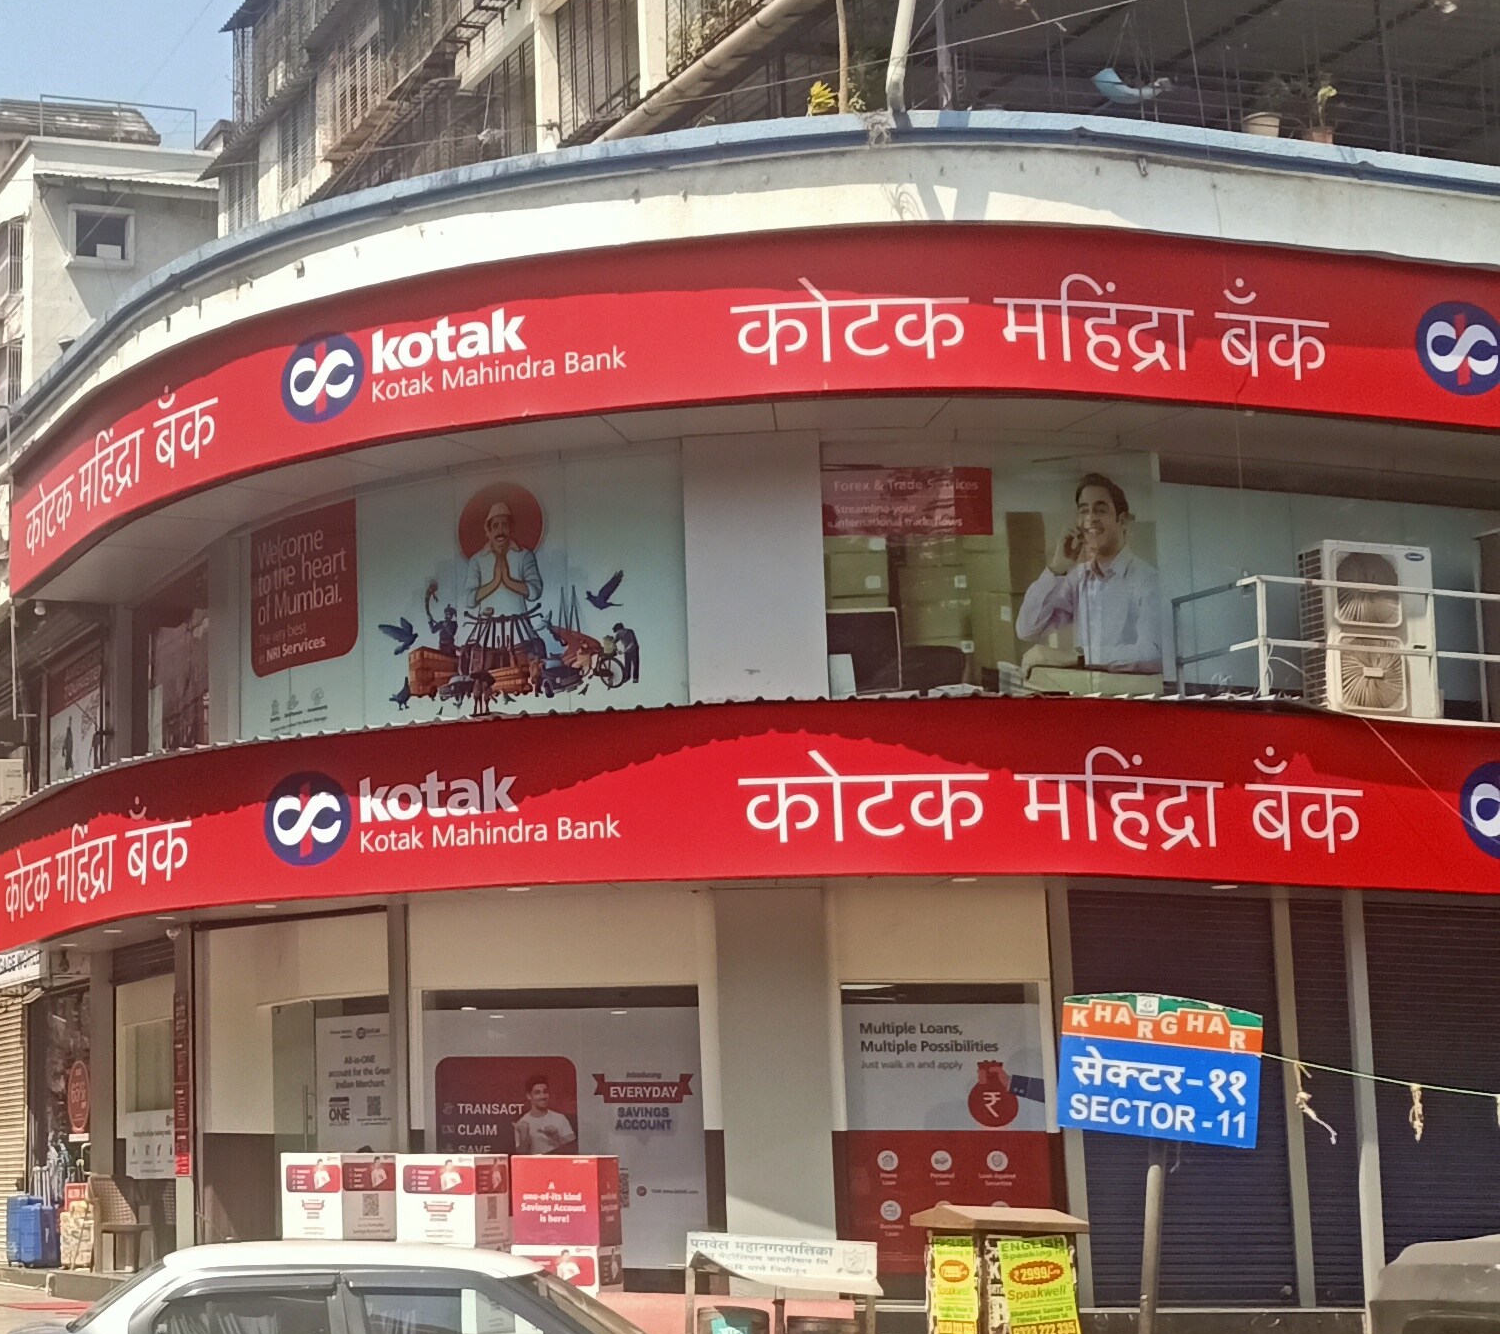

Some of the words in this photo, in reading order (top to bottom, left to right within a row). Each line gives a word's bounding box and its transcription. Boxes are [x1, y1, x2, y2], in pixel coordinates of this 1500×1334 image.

[729, 277, 969, 366] कोटक
[993, 273, 1195, 373] महिंद्रा
[1214, 277, 1330, 381] बँक
[371, 308, 526, 370] kotak
[371, 371, 434, 403] Kotak
[441, 354, 556, 393] Mahindra
[564, 345, 627, 375] Bank
[25, 474, 75, 556] कोटक
[78, 427, 145, 512] महिंद्रा
[152, 385, 219, 469] बँक
[834, 481, 870, 492] Forex
[873, 480, 884, 491] &
[887, 479, 923, 491] Trade
[257, 529, 324, 567] Welcome
[258, 574, 271, 597] to
[273, 565, 296, 589] the
[301, 547, 347, 582] heart
[258, 595, 270, 626] of
[274, 575, 343, 619] Mumbai.
[266, 646, 281, 662] NRI
[282, 636, 326, 657] Services
[359, 766, 520, 824] kotak
[737, 749, 990, 844] कोटक
[1013, 746, 1224, 851] महिंद्रा
[1244, 746, 1364, 854] बँक
[360, 825, 424, 854] Kotak
[431, 815, 548, 848] Mahindra
[557, 813, 621, 841] Bank
[3, 849, 52, 922] कोटक
[55, 823, 117, 904] महिंद्रा
[124, 796, 193, 886] बँक
[859, 1022, 917, 1037] Multiple
[919, 1023, 963, 1036] Loans,
[1070, 1004, 1248, 1050] KHARGHAR
[860, 1040, 917, 1055] Multiple
[921, 1040, 999, 1053] Possibilities
[881, 1060, 904, 1069] walk
[918, 1060, 936, 1069] and
[938, 1061, 963, 1071] apply
[609, 1085, 678, 1098] EVERYDAY
[329, 1108, 350, 1121] ONE
[457, 1103, 524, 1115] TRANSACT
[617, 1106, 669, 1118] SAVINGS
[1069, 1093, 1196, 1133] SECTOR
[457, 1124, 497, 1136] CLAIM
[615, 1119, 672, 1132] ACCOUNT
[458, 1144, 491, 1154] SAVE
[523, 1192, 562, 1202] one-of-its
[563, 1192, 582, 1202] kind
[521, 1203, 552, 1214] Savings
[553, 1203, 586, 1213] Account
[539, 1214, 547, 1223] is
[548, 1214, 570, 1223] here!
[690, 1238, 729, 1251] पनवेल
[736, 1241, 834, 1258] महानगरपालिका
[1000, 1237, 1065, 1253] ENGLISH
[1002, 1249, 1052, 1261] Speaking
[1007, 1284, 1066, 1303] Speakwell
